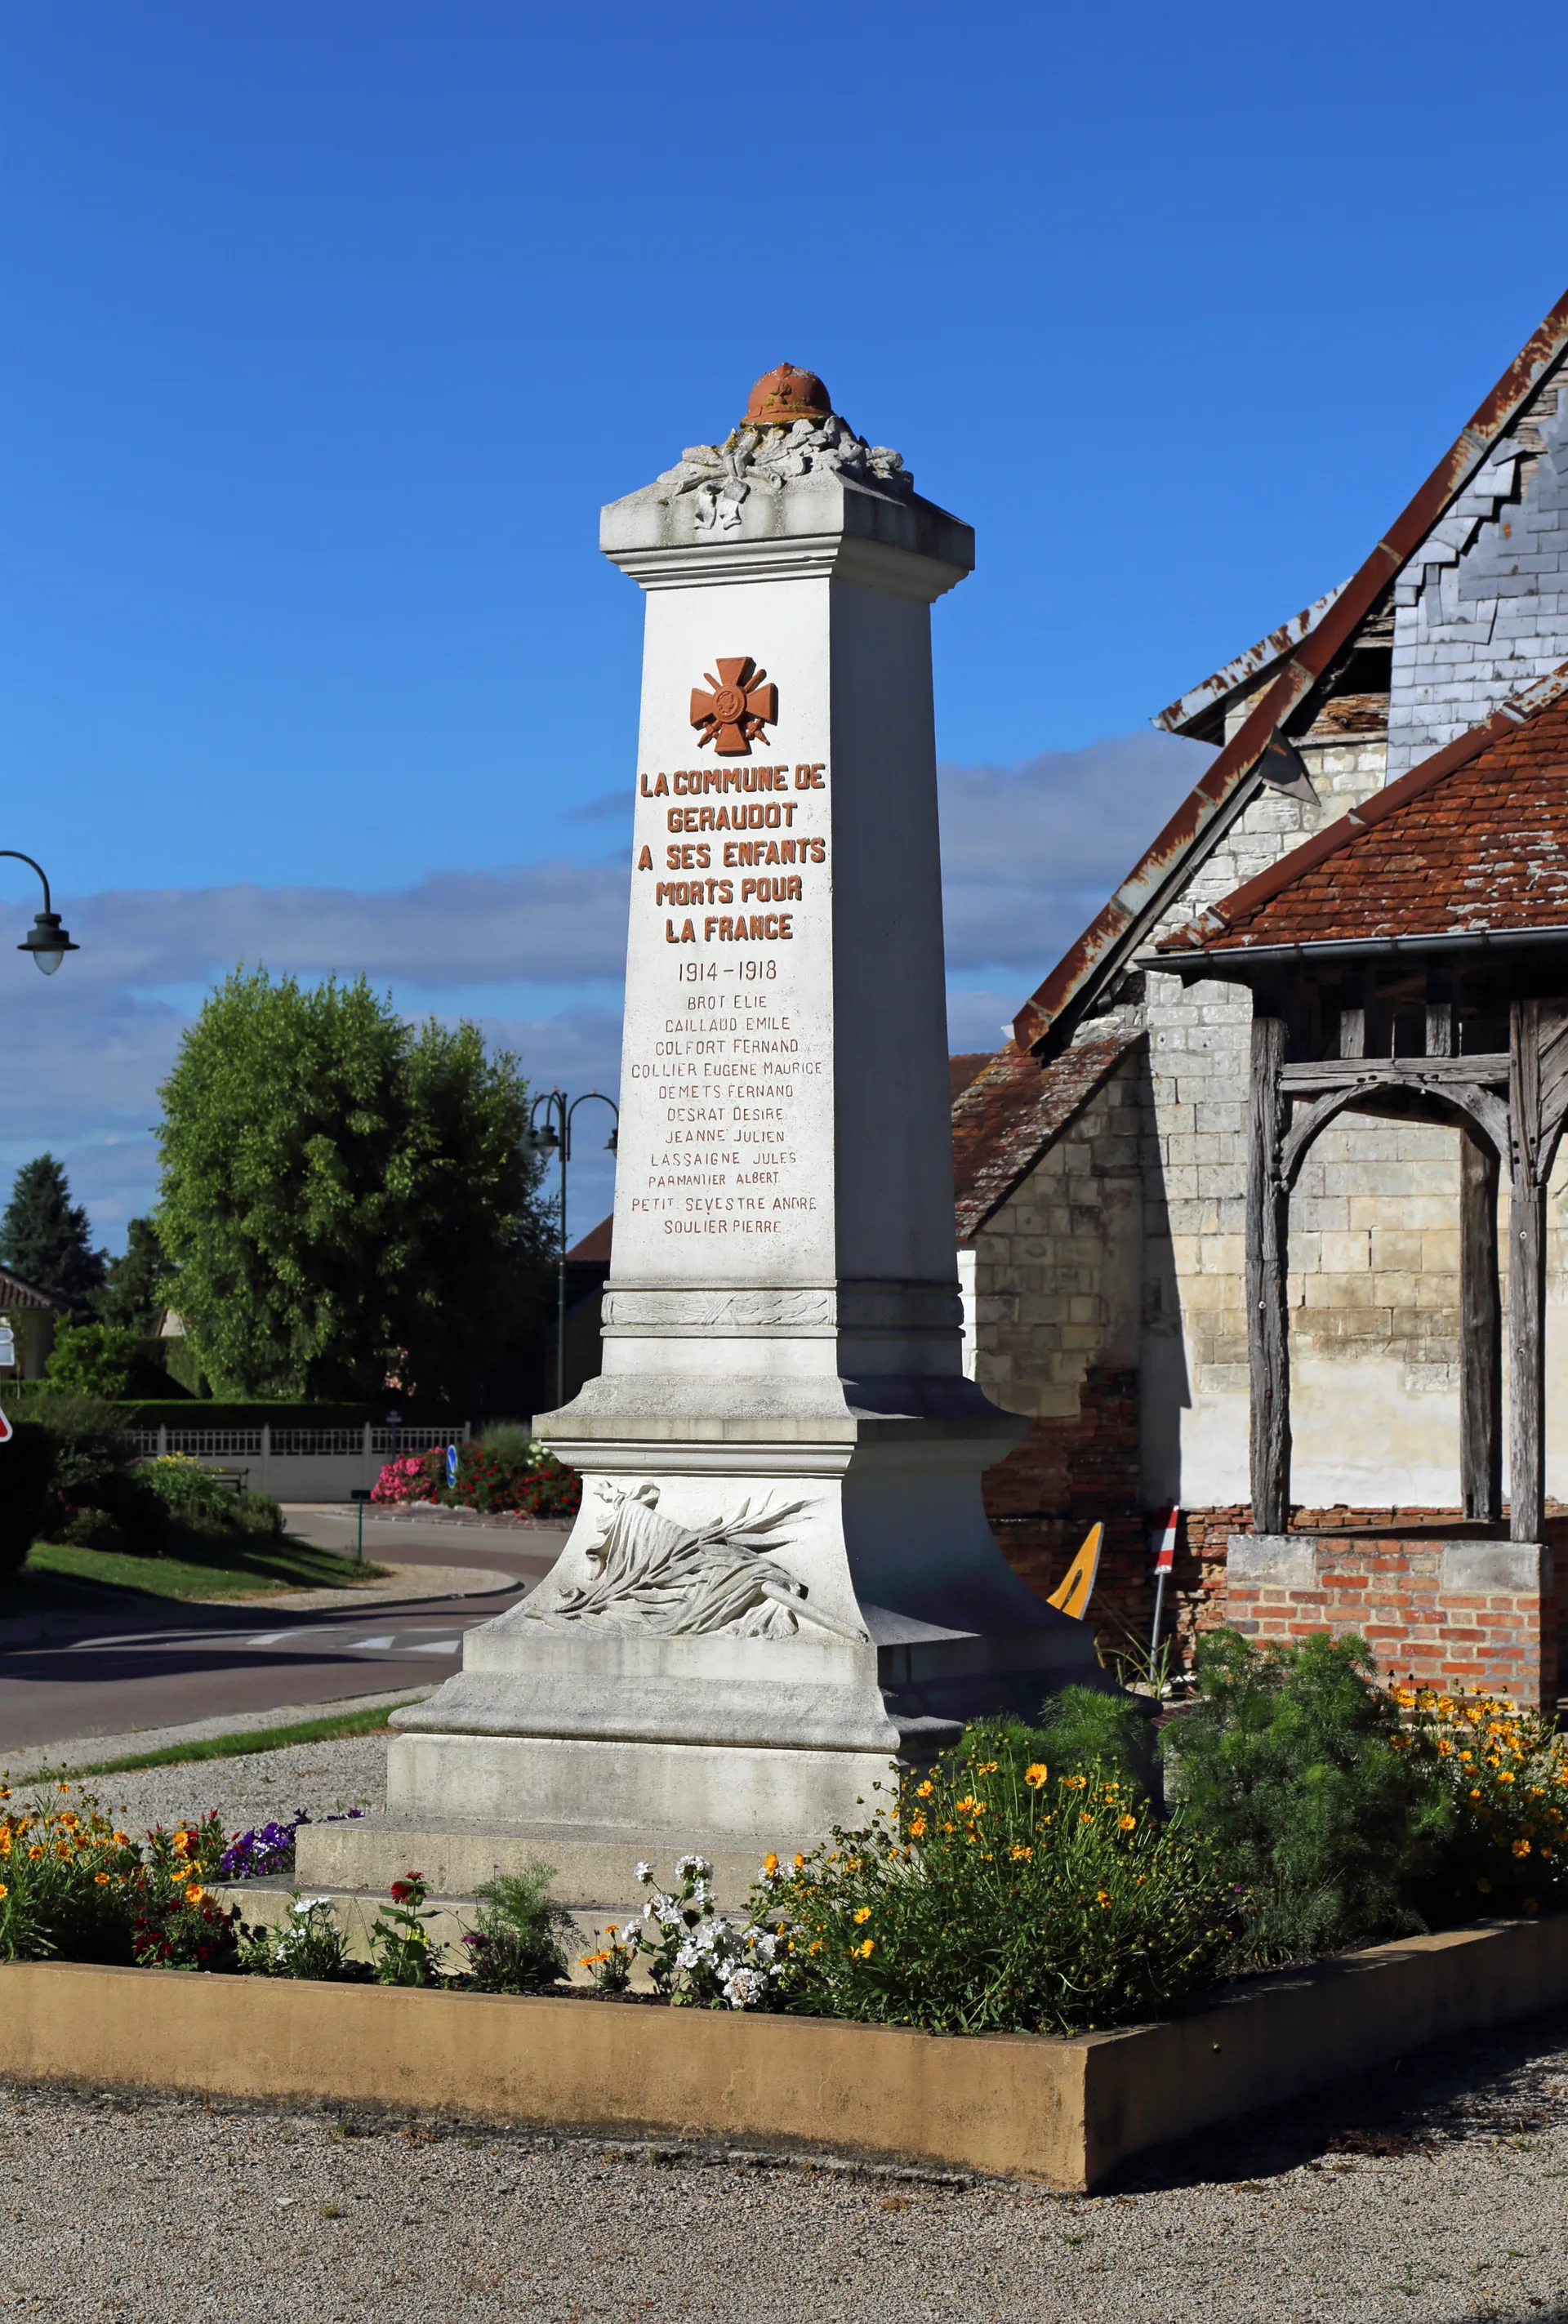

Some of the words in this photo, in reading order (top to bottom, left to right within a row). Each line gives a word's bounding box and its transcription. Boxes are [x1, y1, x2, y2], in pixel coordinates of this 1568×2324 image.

[641, 772, 668, 797] LA
[673, 765, 788, 795] COMMUNE
[795, 764, 825, 790] DE
[667, 803, 797, 832] GERAUDOT
[638, 845, 653, 870] A
[666, 843, 710, 869] SES
[724, 837, 826, 867] ENFANTS
[657, 879, 733, 906] MORTS
[742, 875, 802, 902] POUR
[666, 918, 695, 942] LA
[705, 914, 793, 942] FRANCE
[688, 995, 724, 1010] BROT
[734, 995, 767, 1008] ELIE
[666, 1018, 737, 1033] CAILLAUD
[746, 1017, 790, 1031] EMILE
[656, 1040, 725, 1056] COLFORT
[733, 1040, 799, 1053] FERNAND
[632, 1063, 697, 1079] COLLIER
[704, 1064, 756, 1076] EUGENE
[764, 1062, 822, 1075] MAURICE
[659, 1084, 721, 1099] DEMETS
[728, 1084, 793, 1097] FERNAND
[667, 1108, 724, 1122] DESRAT
[733, 1108, 783, 1120] DESIRE
[666, 1131, 724, 1144] JEANNE
[733, 1130, 785, 1142] JULIEN
[651, 1152, 740, 1167] LASSAIGNE
[753, 1152, 796, 1164] JULES
[737, 1172, 779, 1184] ALBERT
[773, 1197, 817, 1211] ANDRE
[665, 1220, 728, 1234] SOULIER
[733, 1220, 781, 1233] PIERRE
